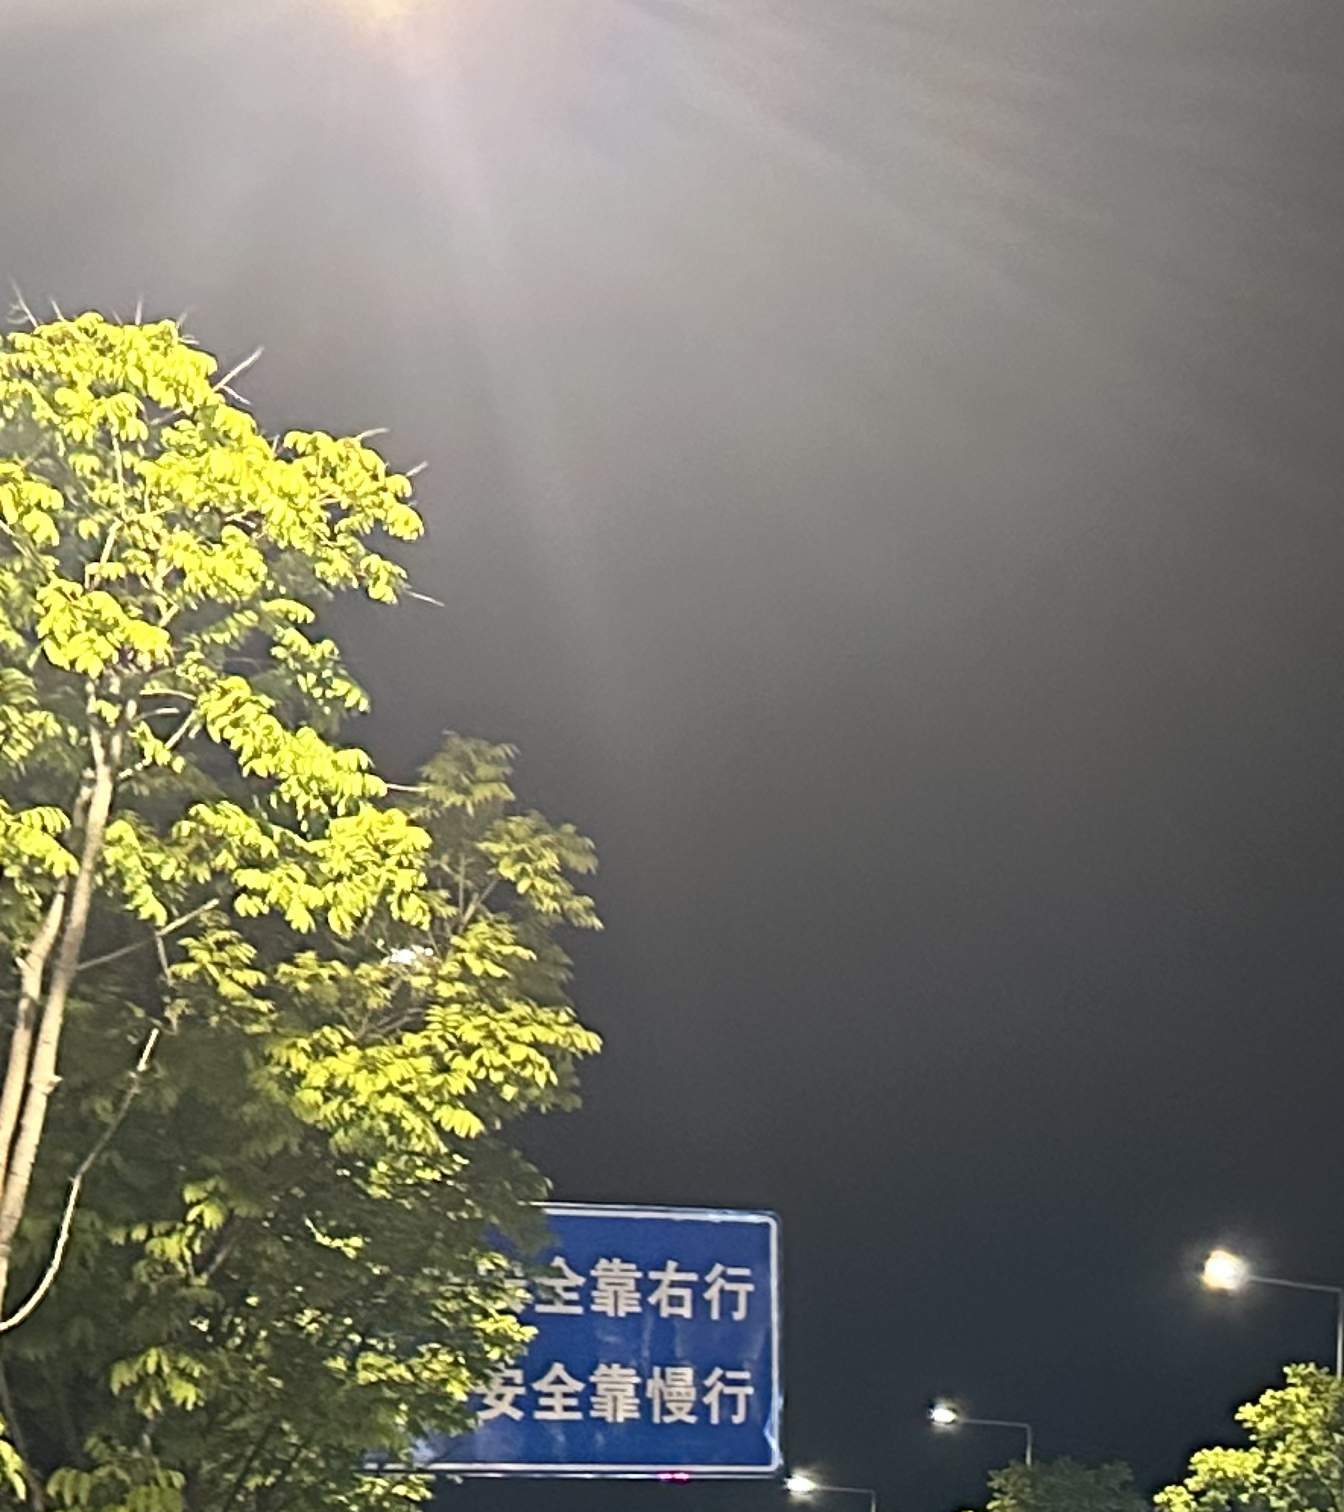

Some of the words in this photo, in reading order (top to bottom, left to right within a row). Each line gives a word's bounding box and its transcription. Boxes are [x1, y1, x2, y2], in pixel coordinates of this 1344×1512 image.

[472, 1361, 754, 1425] 安全靠慢行
